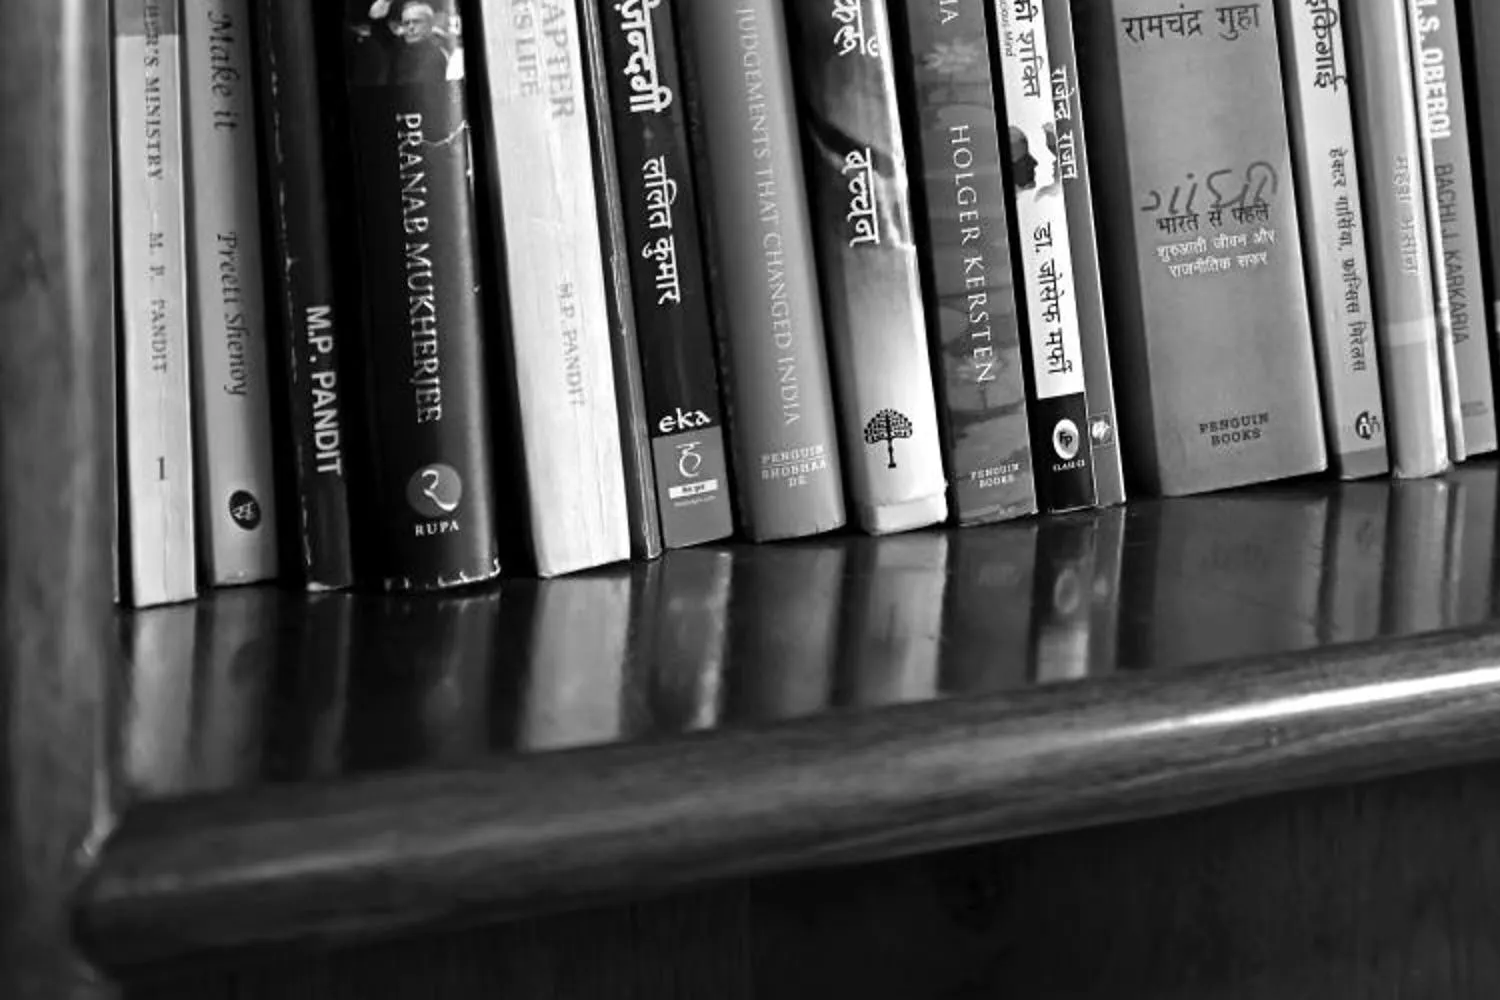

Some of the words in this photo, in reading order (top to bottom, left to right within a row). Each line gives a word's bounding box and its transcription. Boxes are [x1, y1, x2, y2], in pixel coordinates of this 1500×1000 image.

[207, 10, 241, 98] Make
[1121, 3, 1204, 43] रामचंद्र
[1216, 2, 1262, 41] गुहा
[514, 37, 540, 99] LIFE
[736, 7, 772, 161] JUDGEMENTS
[1017, 29, 1045, 100] शक्ति
[1422, 46, 1452, 140] OBEROI
[144, 77, 164, 181] MINISTRY
[213, 108, 238, 132] it
[1056, 131, 1080, 181] राजन
[396, 112, 430, 234] PRANAB
[641, 155, 676, 229] ललित
[757, 165, 780, 219] THAT
[841, 147, 881, 248] बच्चन
[947, 124, 983, 248] HOLGER
[1434, 163, 1458, 223] BACHI
[1156, 213, 1200, 234] भारत
[215, 231, 243, 307] Preeti
[641, 235, 682, 305] कुमार
[761, 231, 794, 352] CHANGED
[1443, 249, 1470, 346] KARKARIA
[150, 298, 168, 374] PANDIT
[222, 316, 249, 397] Shenoy
[305, 305, 334, 363] M.P.
[405, 241, 444, 424] MUKHERJEE
[962, 254, 998, 387] KERSTEN
[561, 328, 587, 407] PANDIT
[776, 357, 803, 427] INDIA
[311, 370, 344, 476] PANDIT
[658, 407, 713, 433] eka
[760, 444, 825, 466] PENGUIN
[1199, 413, 1270, 434] PENGUIN
[1210, 427, 1262, 446] BOOKS
[969, 463, 1020, 481] PENGUIN
[413, 518, 462, 538] RUPA
